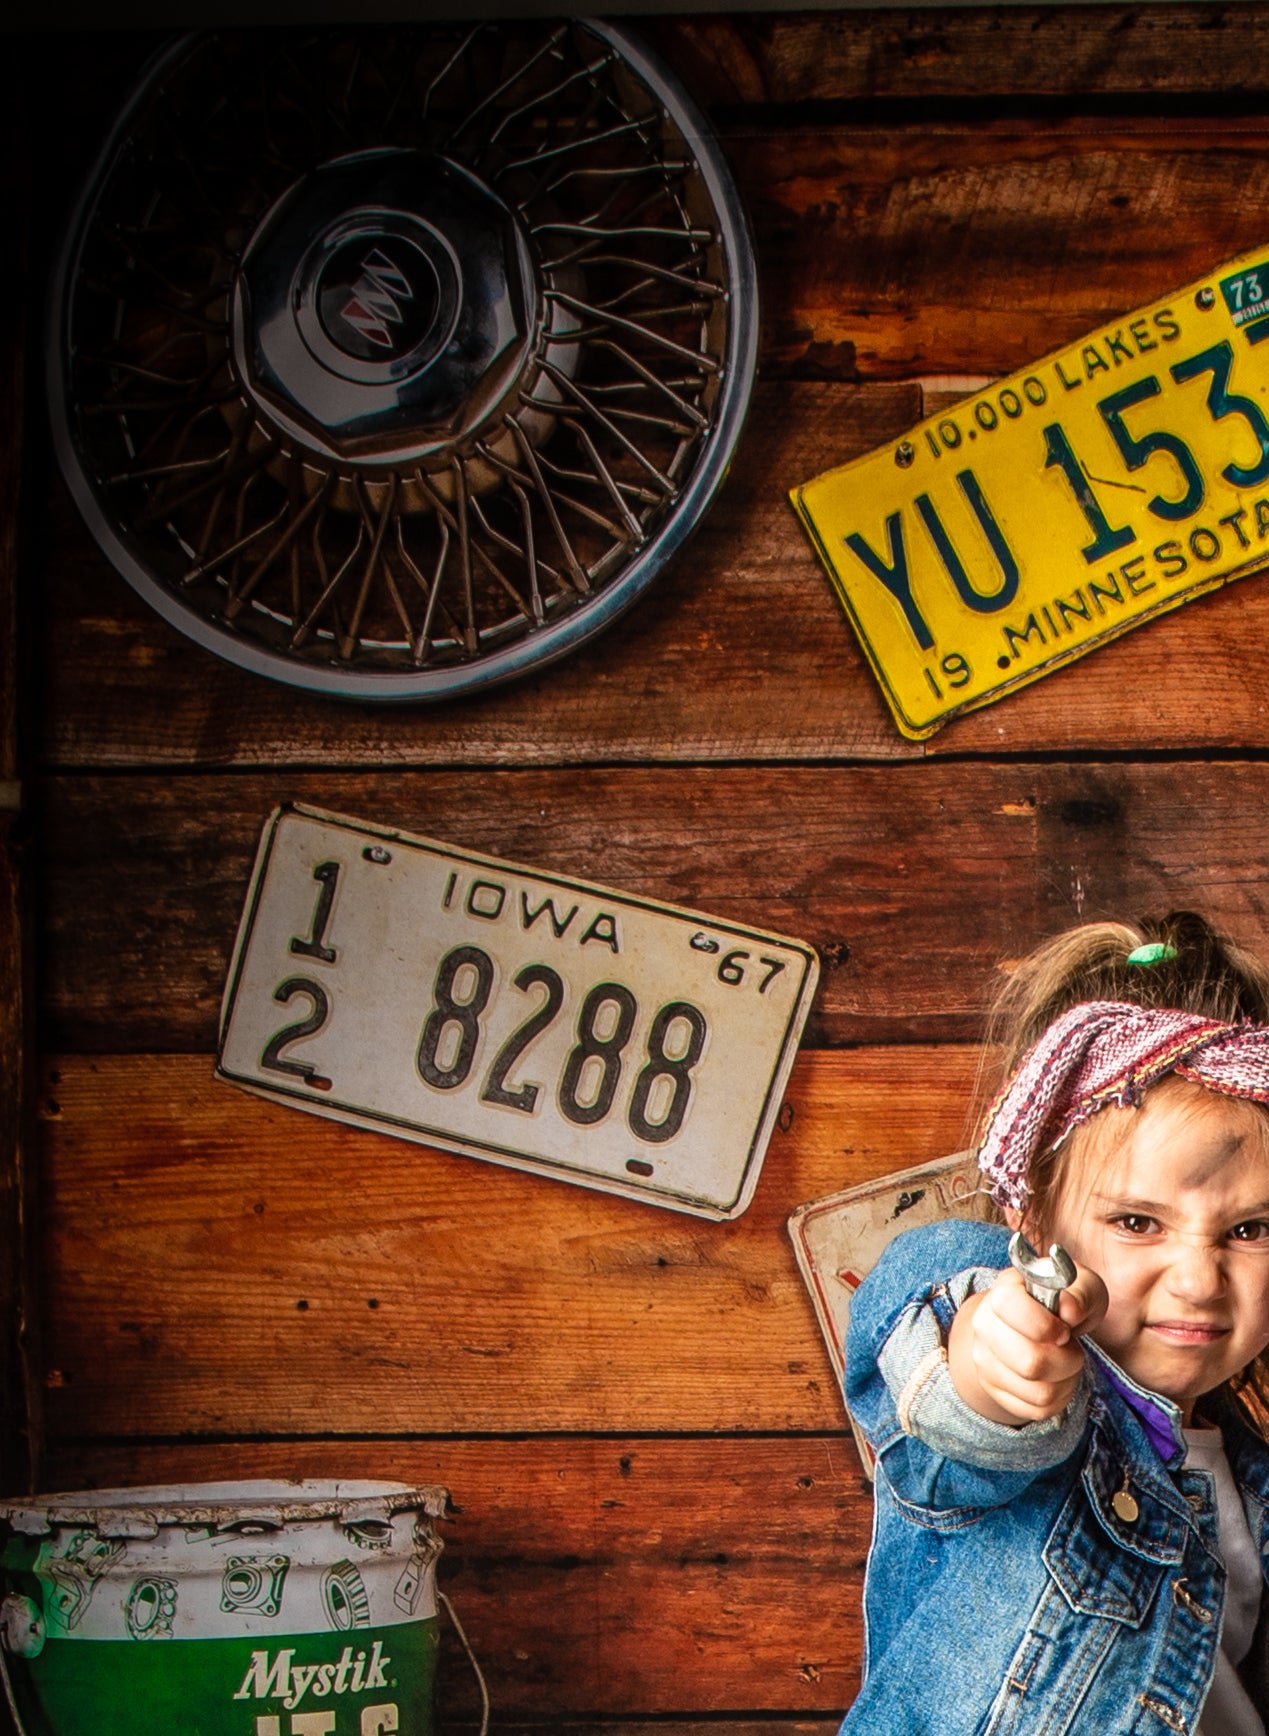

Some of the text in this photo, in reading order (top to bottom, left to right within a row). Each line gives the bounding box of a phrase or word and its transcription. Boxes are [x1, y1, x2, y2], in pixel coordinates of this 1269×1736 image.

[1230, 272, 1263, 310] 73
[1054, 309, 1182, 391] LAKES
[844, 469, 1019, 650] YU
[923, 651, 971, 698] 19
[444, 871, 786, 994] IOWA 67
[417, 944, 709, 1145] 8288
[233, 1640, 391, 1709] Mystik
